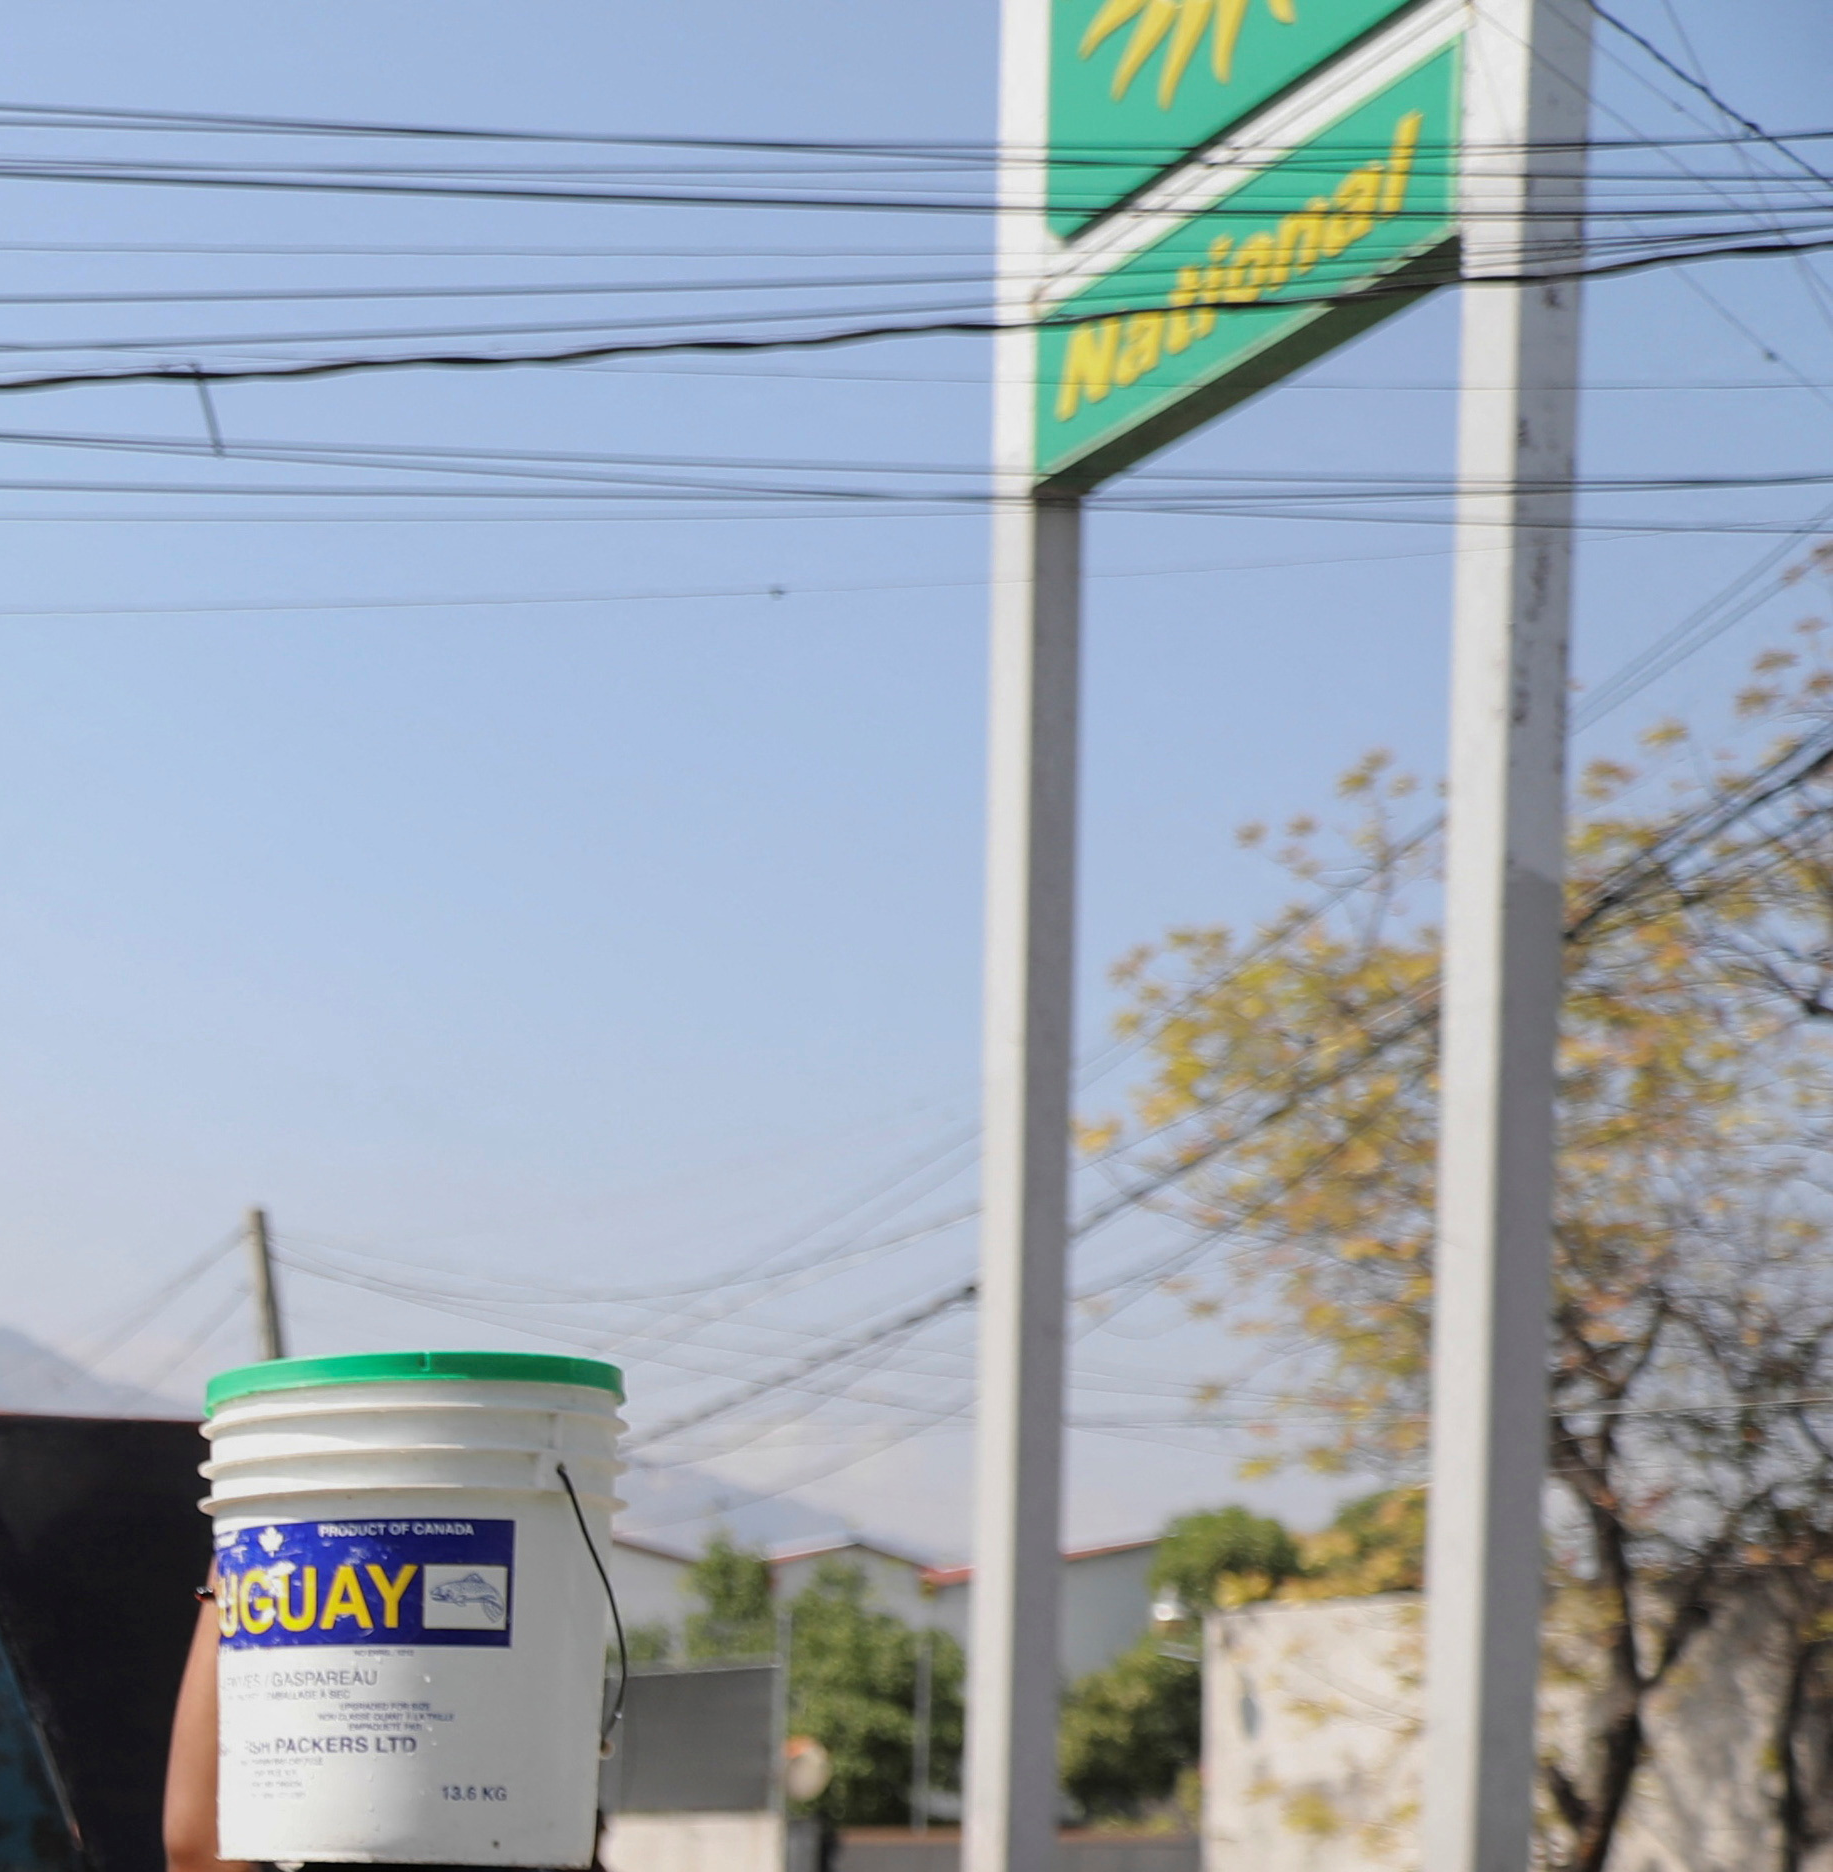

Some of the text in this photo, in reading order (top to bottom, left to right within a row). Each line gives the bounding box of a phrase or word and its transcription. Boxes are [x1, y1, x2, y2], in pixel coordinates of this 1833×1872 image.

[1055, 109, 1424, 422] National
[317, 1523, 475, 1538] PRODUCT OF CANADA
[271, 1669, 378, 1687] GASPAREAU
[276, 1736, 369, 1754] PACKERS
[376, 1736, 418, 1754] LTD
[442, 1785, 508, 1801] 13.6 KG
